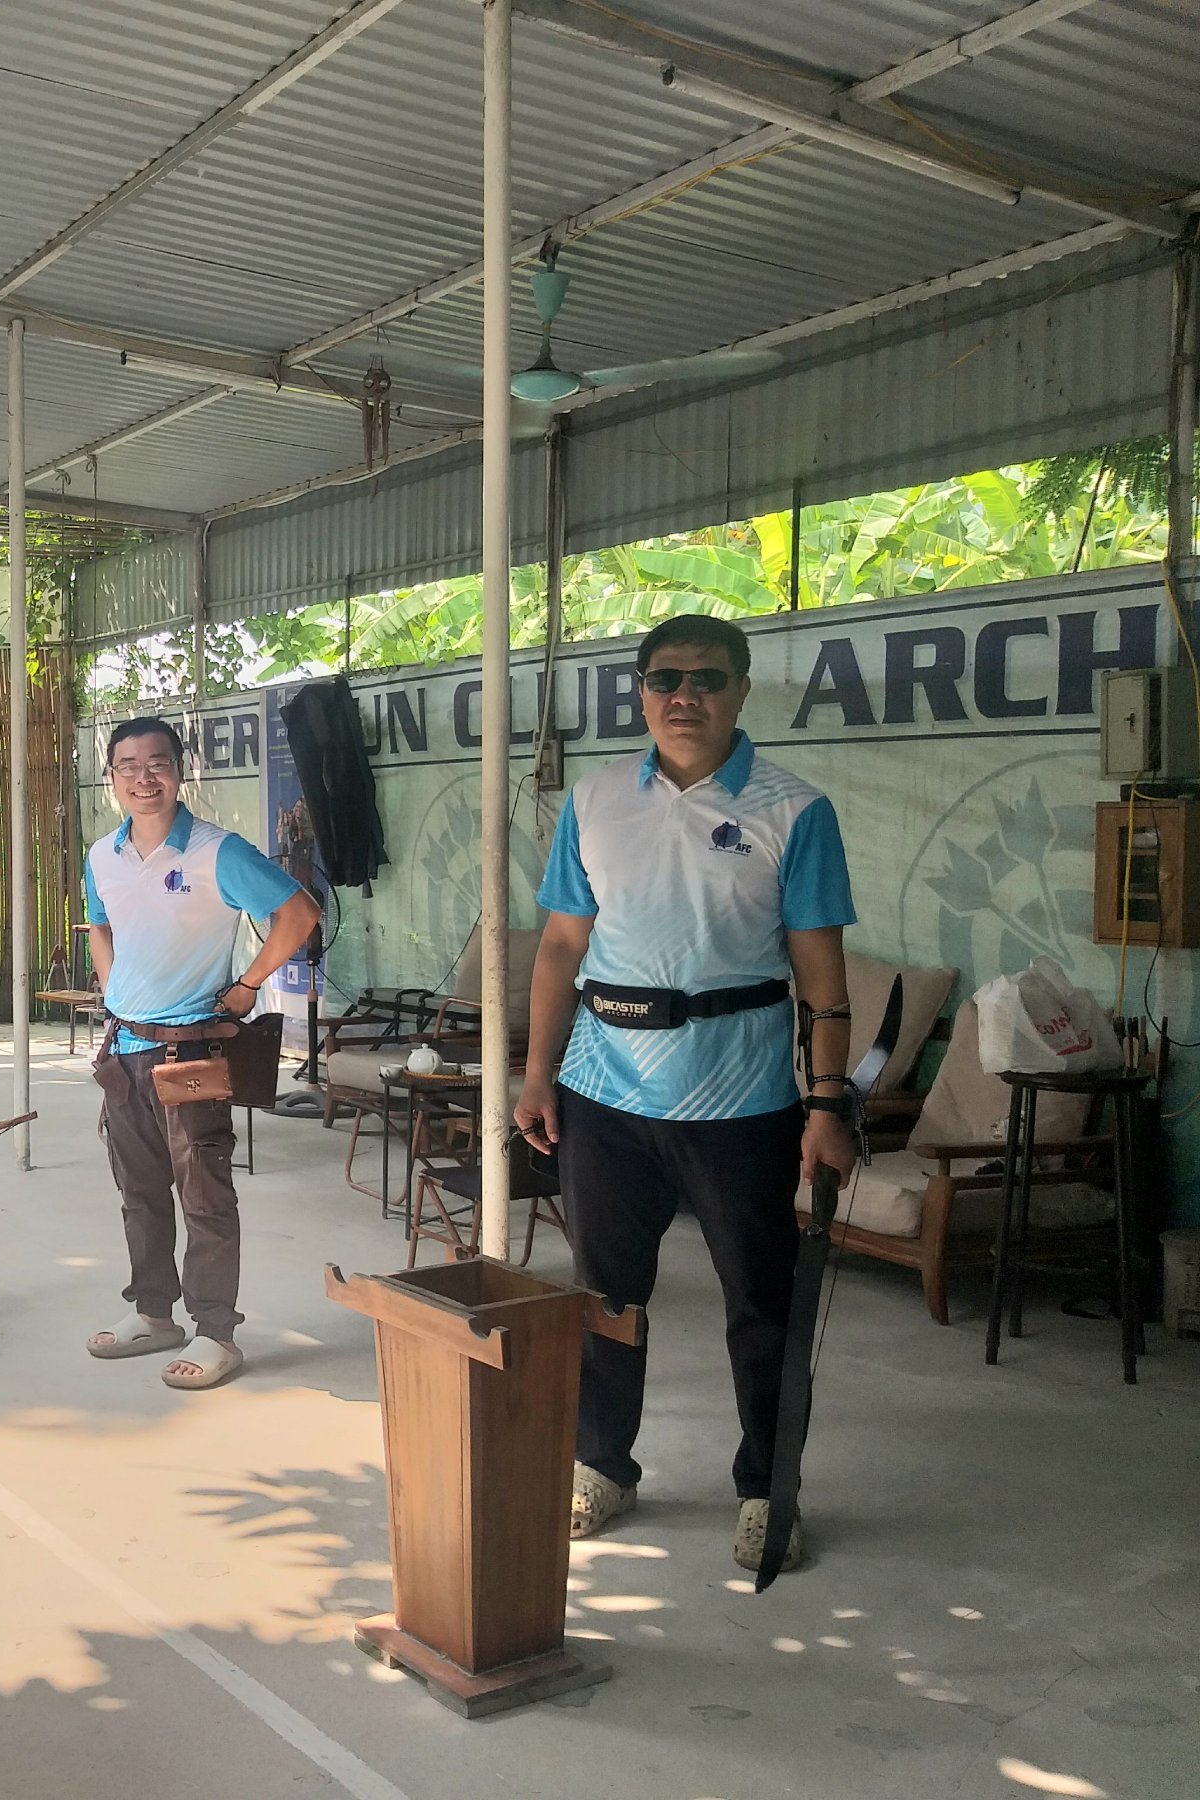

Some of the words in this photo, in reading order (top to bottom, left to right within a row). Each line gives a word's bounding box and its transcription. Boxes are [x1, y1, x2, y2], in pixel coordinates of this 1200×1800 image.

[453, 661, 649, 748] CLUB
[790, 603, 1200, 729] ARCH
[735, 843, 752, 853] AFC
[603, 1000, 649, 1015] BICASTER
